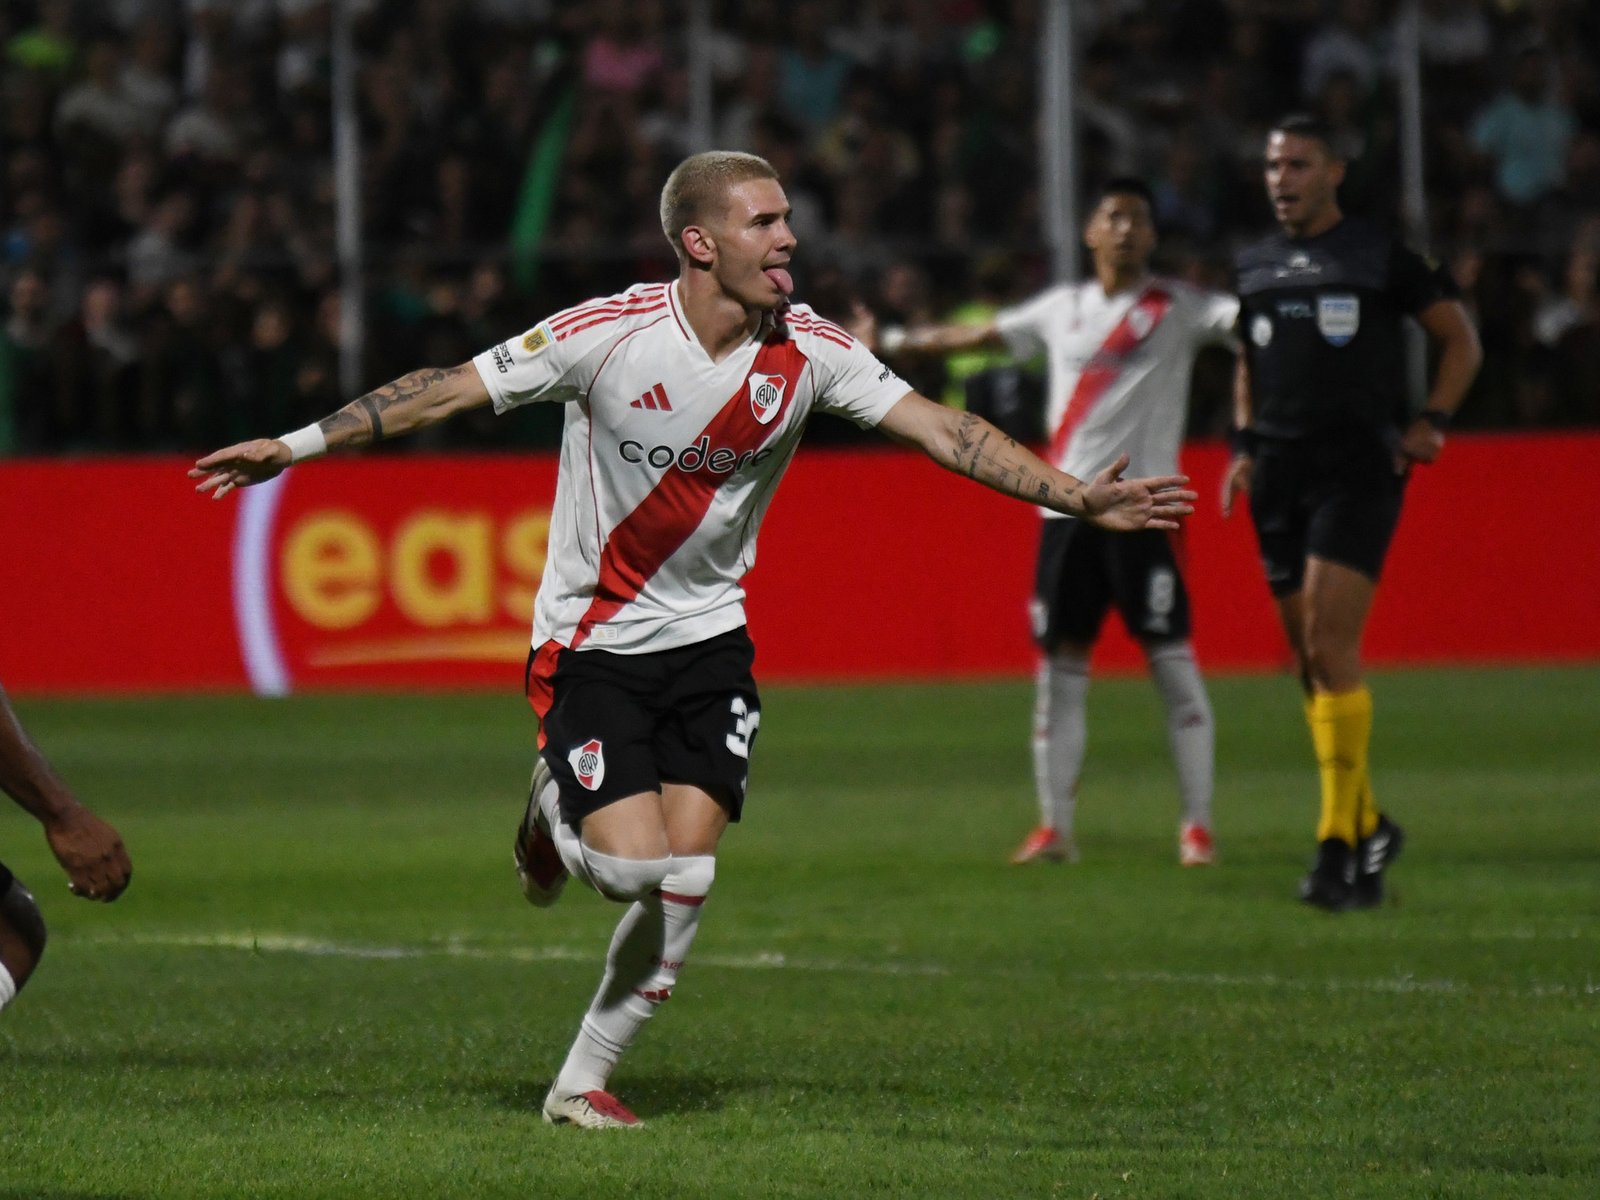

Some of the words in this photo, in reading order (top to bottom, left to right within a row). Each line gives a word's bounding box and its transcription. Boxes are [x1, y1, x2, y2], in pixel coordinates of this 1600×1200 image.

[756, 384, 778, 407] CARP
[618, 436, 773, 474] codere
[578, 753, 599, 776] CARP
